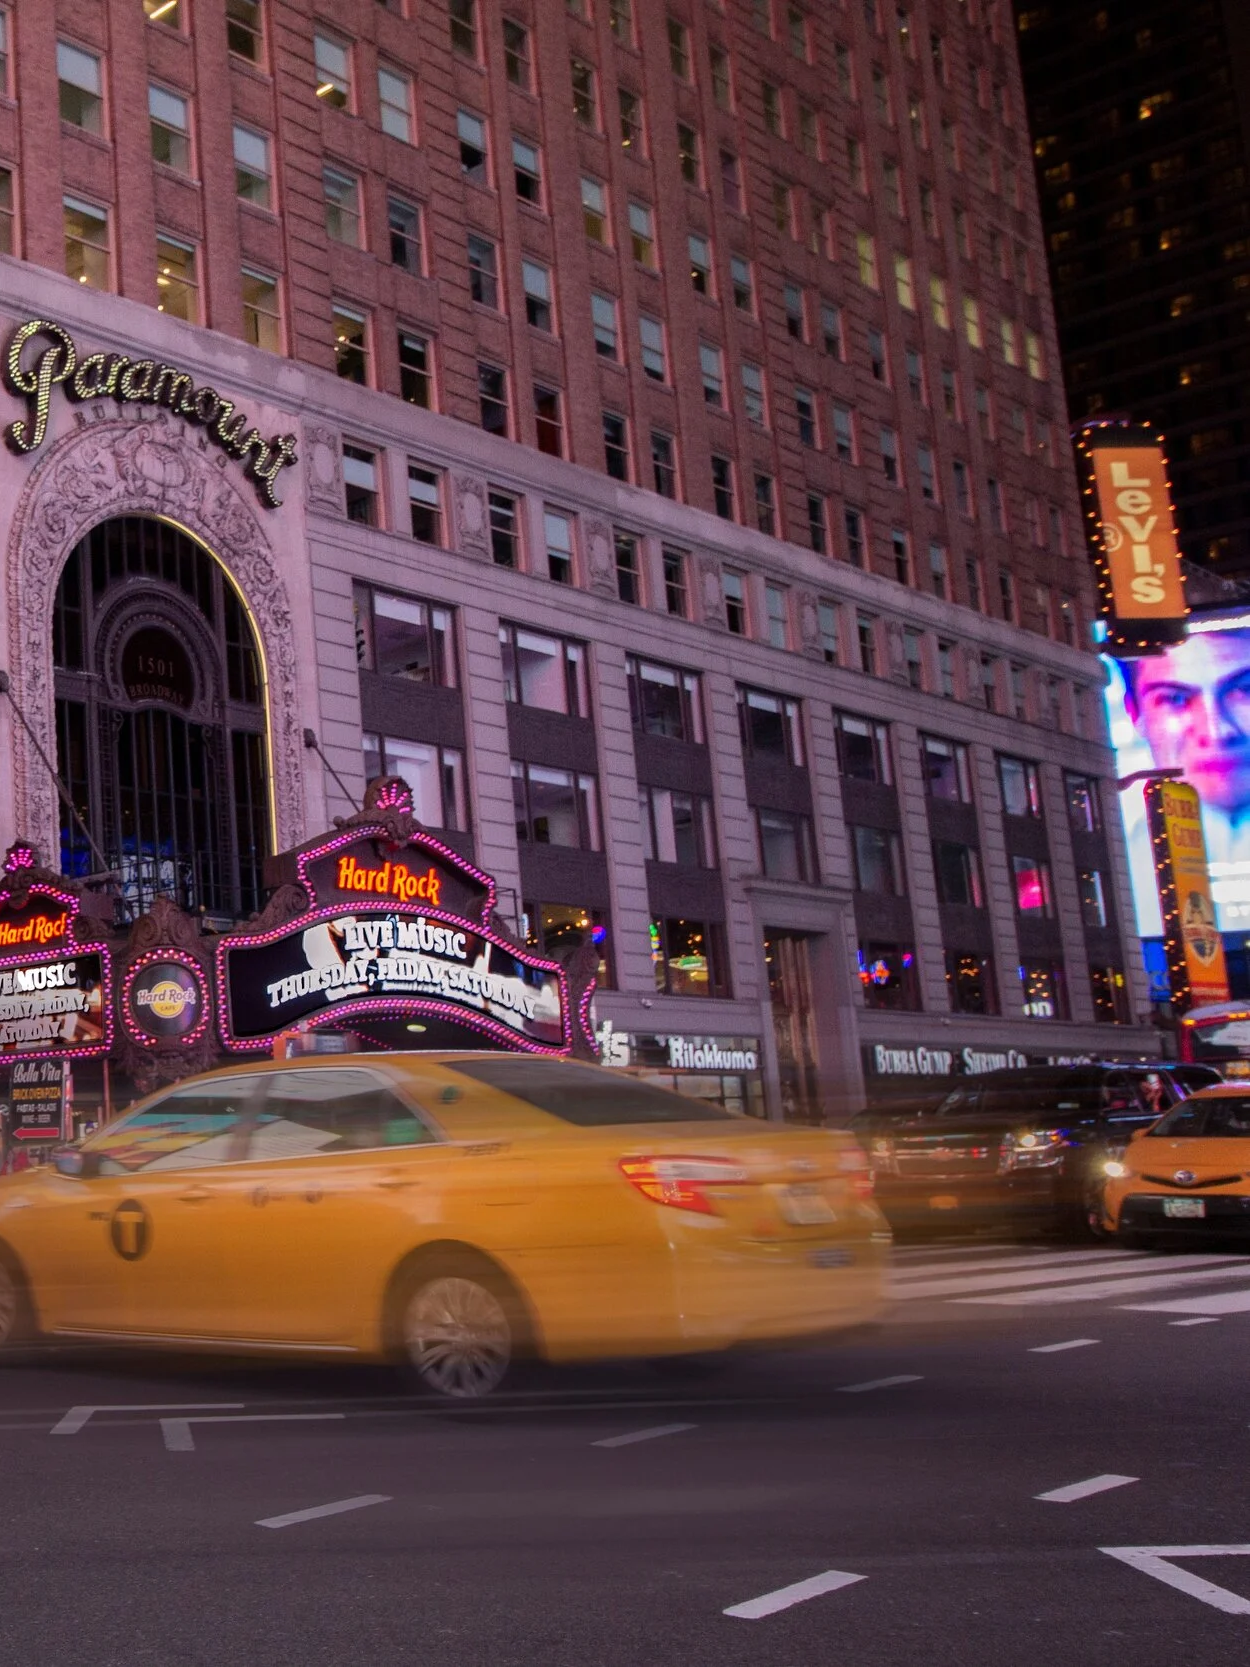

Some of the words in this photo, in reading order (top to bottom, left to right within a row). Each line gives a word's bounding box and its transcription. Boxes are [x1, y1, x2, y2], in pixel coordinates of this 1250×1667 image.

[2, 318, 299, 510] Paramount
[138, 655, 174, 678] 1501
[338, 856, 391, 893] Hard
[391, 864, 442, 906] Rock
[343, 920, 394, 951] LIVE
[398, 917, 468, 960] MUSIC
[14, 962, 77, 993] MUSIC
[449, 968, 536, 1020] SATURDAY
[137, 990, 168, 1005] Hard
[168, 987, 197, 1005] Rock
[669, 1035, 758, 1070] Rilakkuma
[13, 1062, 39, 1083] Bella
[40, 1061, 61, 1082] Vita
